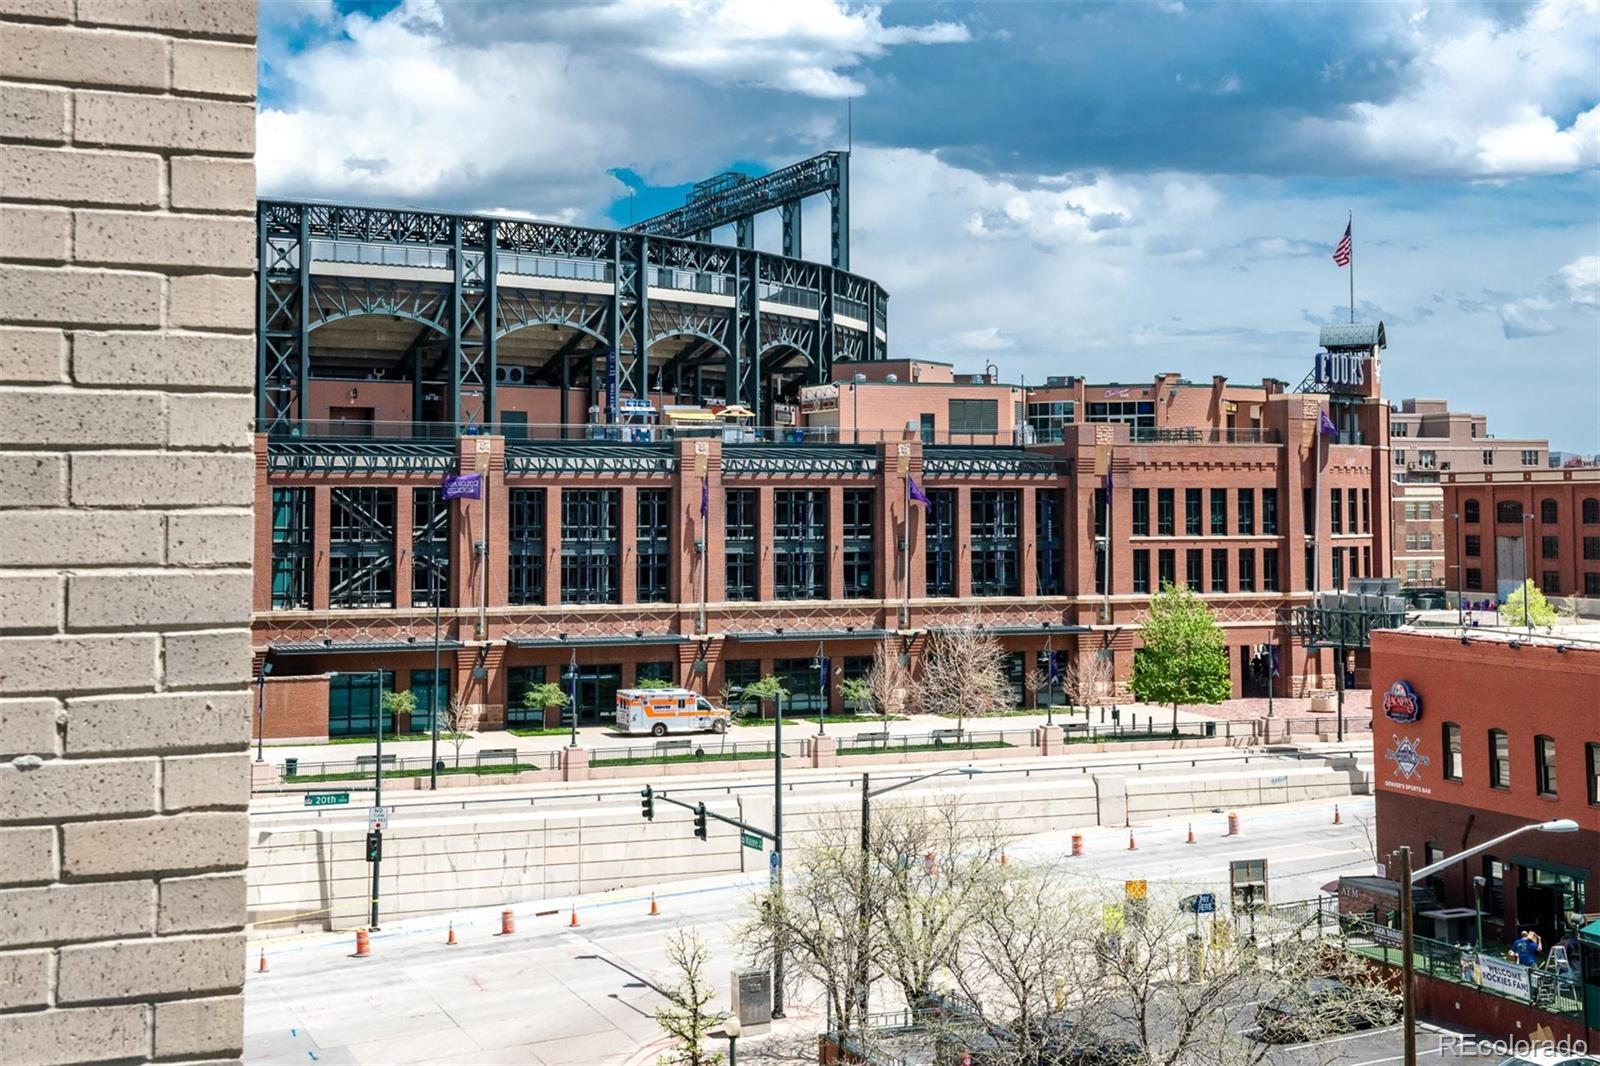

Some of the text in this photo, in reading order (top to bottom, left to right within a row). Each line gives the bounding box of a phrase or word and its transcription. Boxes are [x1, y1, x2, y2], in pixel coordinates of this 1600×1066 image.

[1318, 352, 1365, 386] COORS
[1384, 780, 1405, 789] DENVER'S
[1405, 784, 1421, 792] SPORTS
[315, 795, 336, 804] 20th
[1341, 887, 1359, 898] ATM
[1489, 966, 1522, 982] WELCOME
[1513, 980, 1529, 992] FANS
